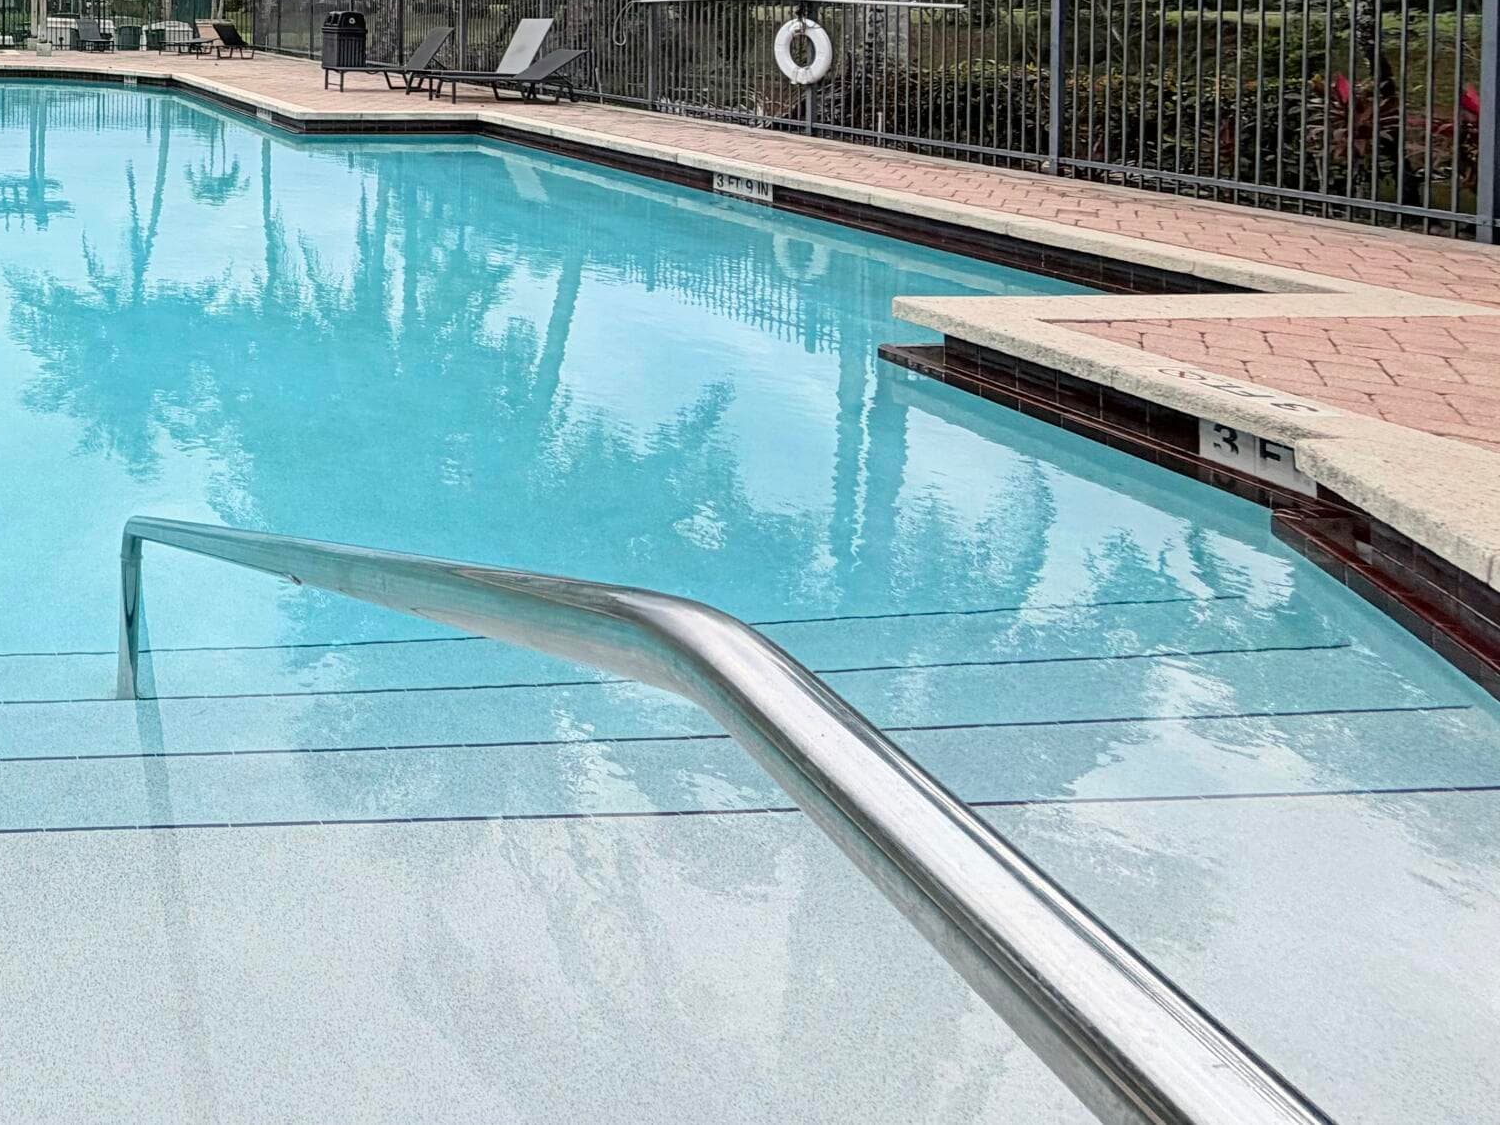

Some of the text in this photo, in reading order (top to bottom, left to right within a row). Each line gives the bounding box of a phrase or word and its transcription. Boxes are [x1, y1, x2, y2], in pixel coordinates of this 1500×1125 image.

[716, 174, 769, 197] 3 FT 9 IN
[1213, 423, 1239, 456] 3
